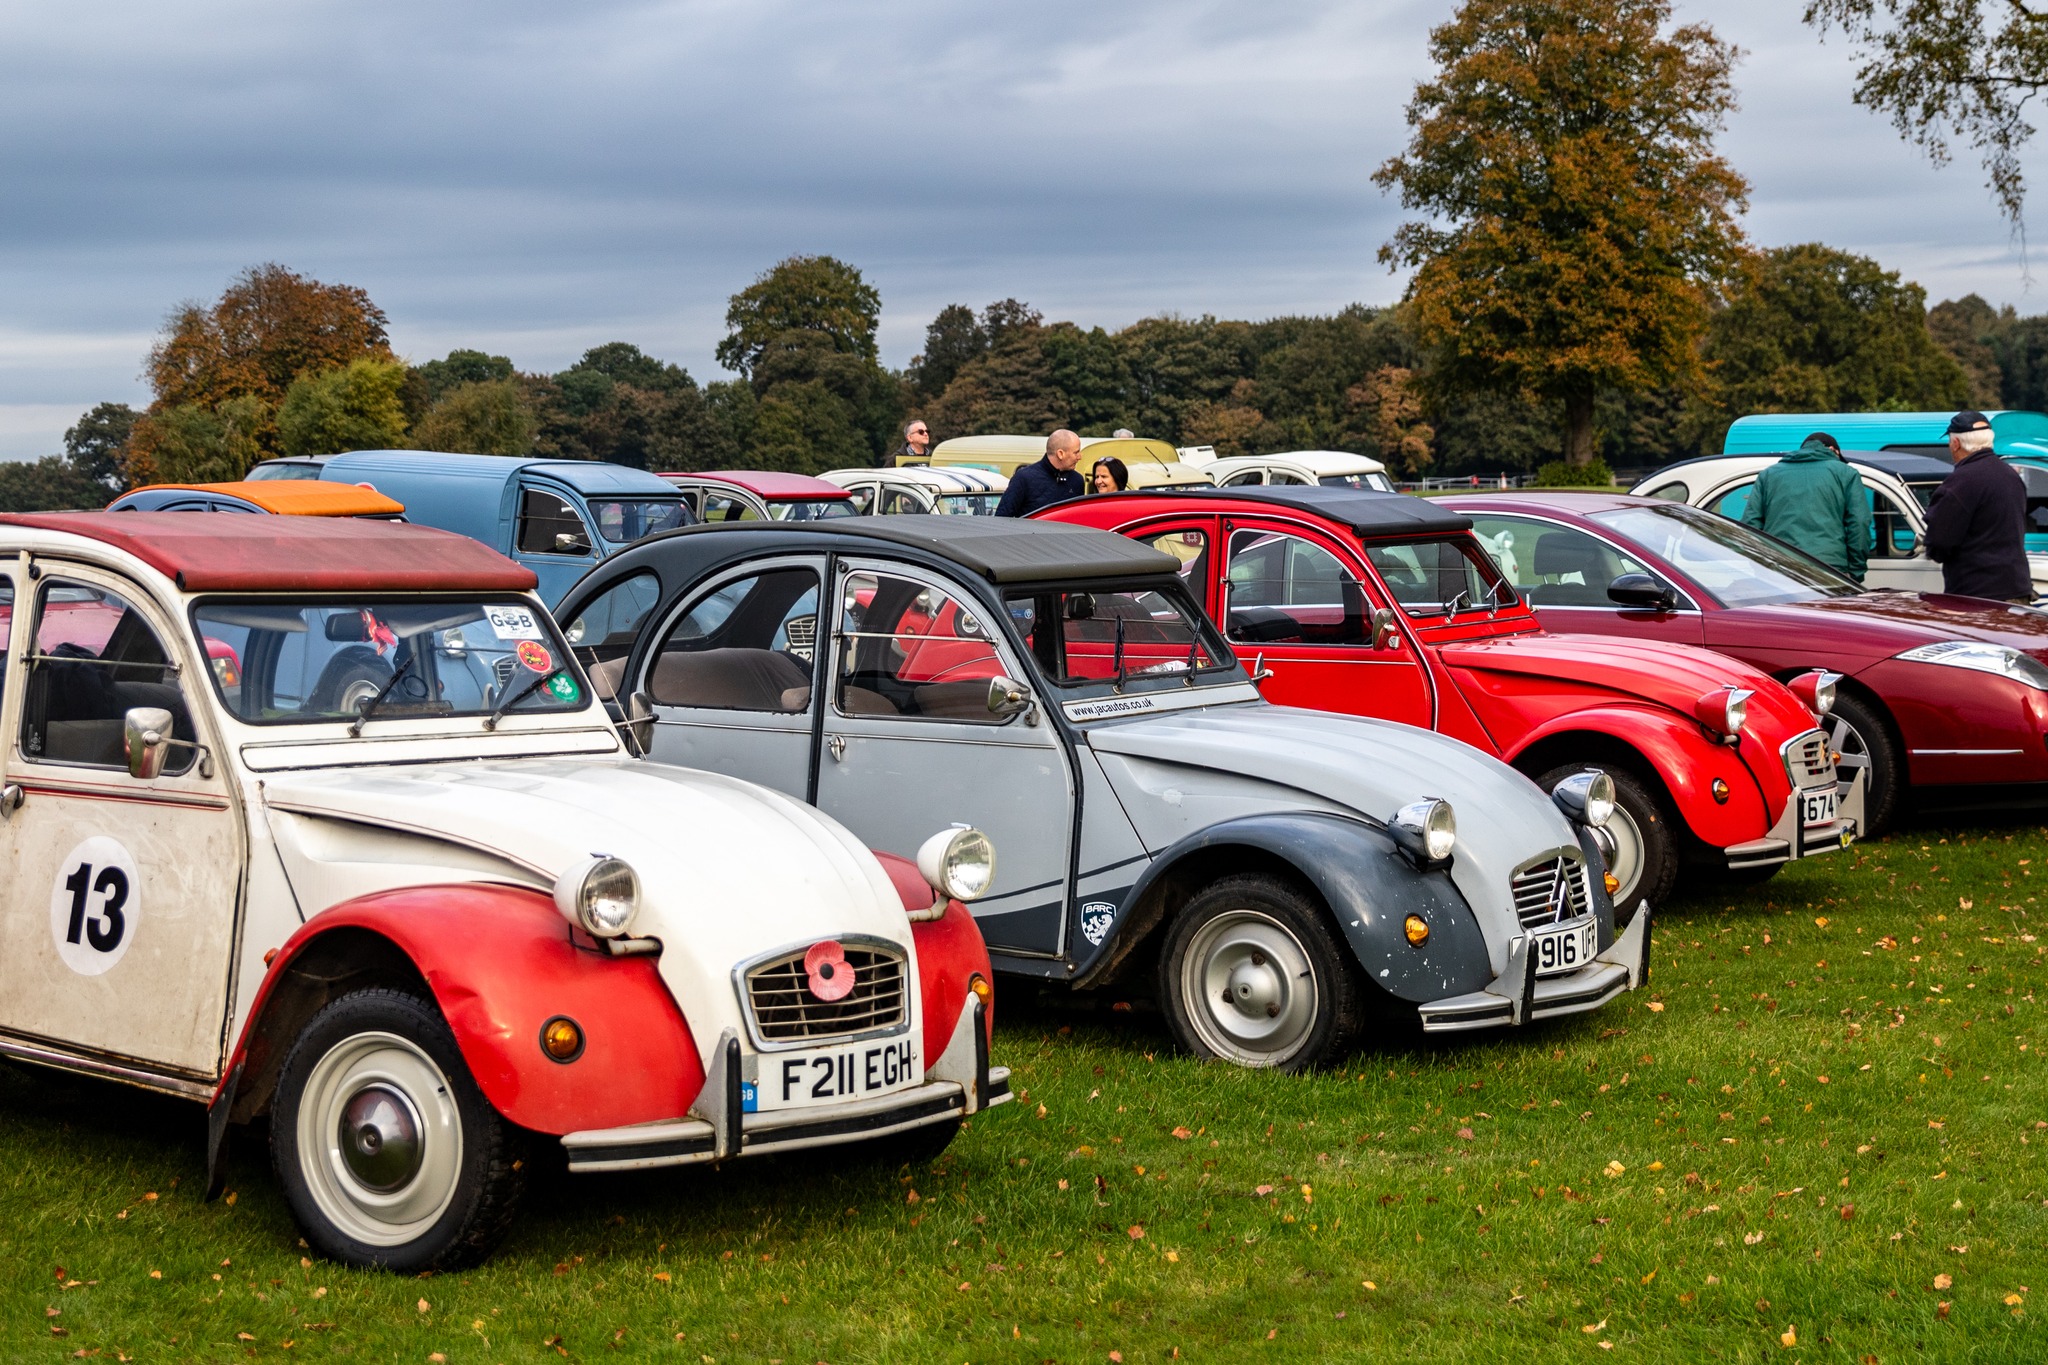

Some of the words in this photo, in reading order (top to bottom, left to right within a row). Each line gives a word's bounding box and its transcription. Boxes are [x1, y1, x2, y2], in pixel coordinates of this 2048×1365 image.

[1072, 698, 1154, 716] www.jacautos.co.uk
[1803, 793, 1834, 822] 674
[65, 861, 130, 953] 13
[1085, 904, 1113, 915] BARC
[1536, 932, 1576, 969] 916
[783, 1053, 855, 1101] F211
[865, 1039, 912, 1091] EGH
